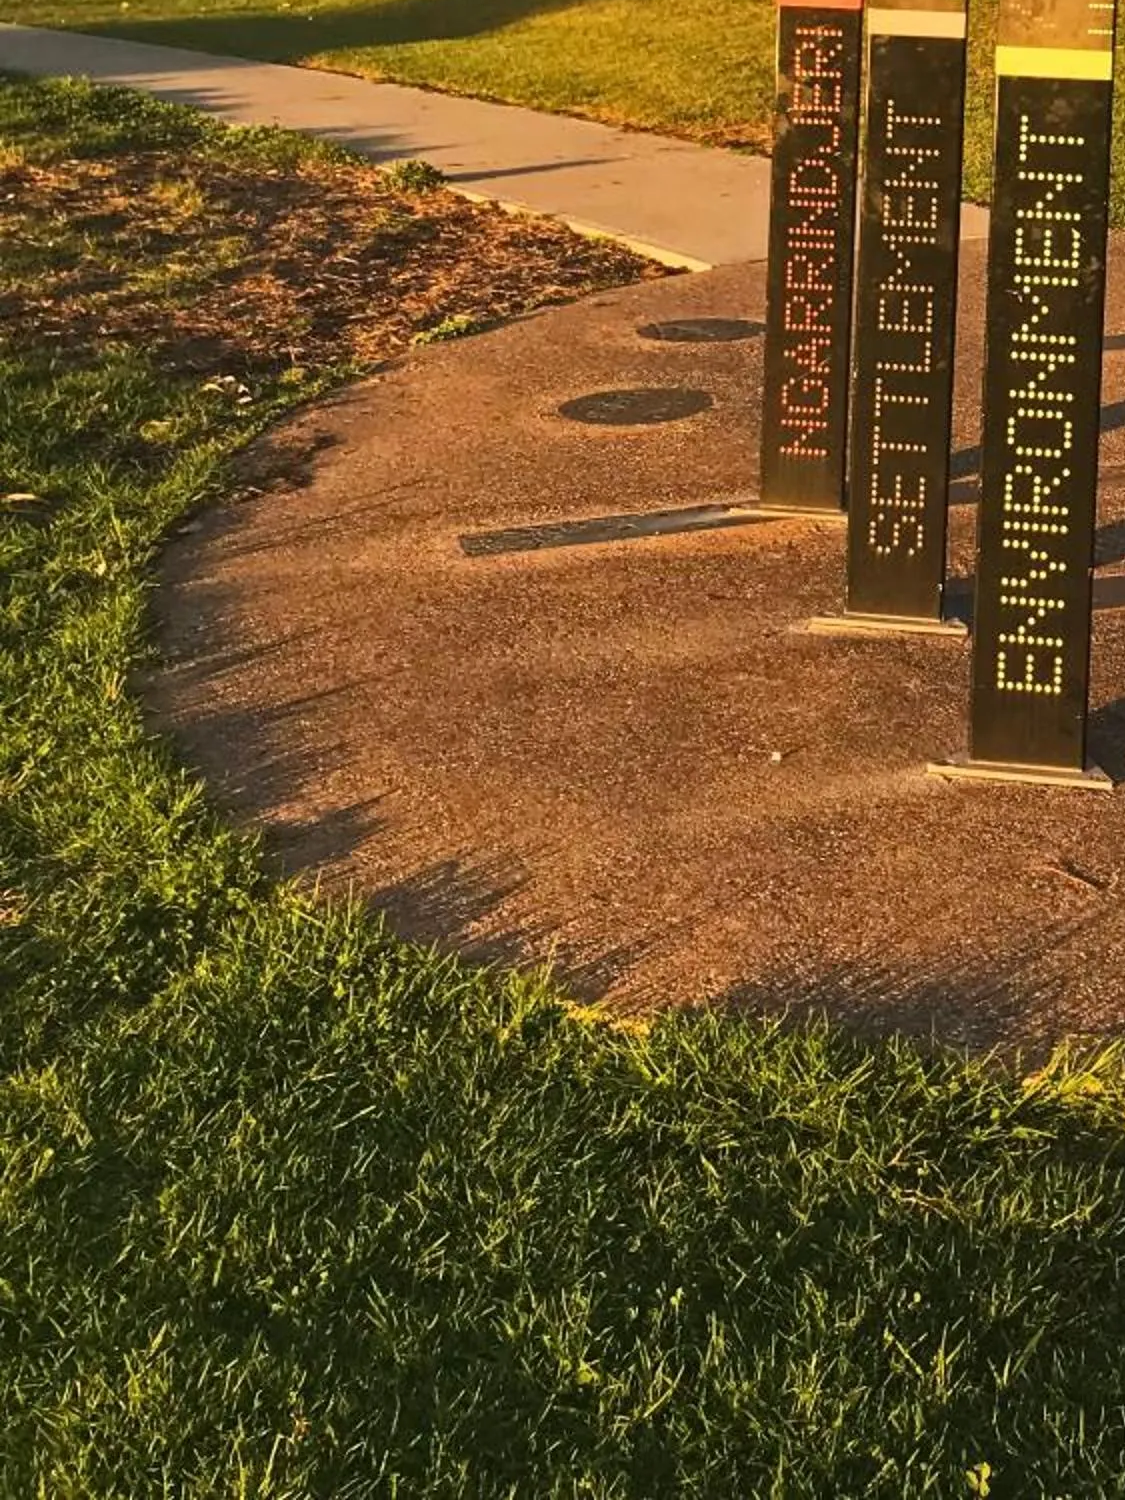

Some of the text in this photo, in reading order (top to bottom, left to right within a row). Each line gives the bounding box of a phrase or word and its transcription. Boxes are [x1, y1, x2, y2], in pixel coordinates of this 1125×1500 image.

[779, 27, 843, 456] NGARRINDJERI
[868, 99, 942, 557] SETTLEMENT
[997, 114, 1085, 695] ENVIRONMENT
